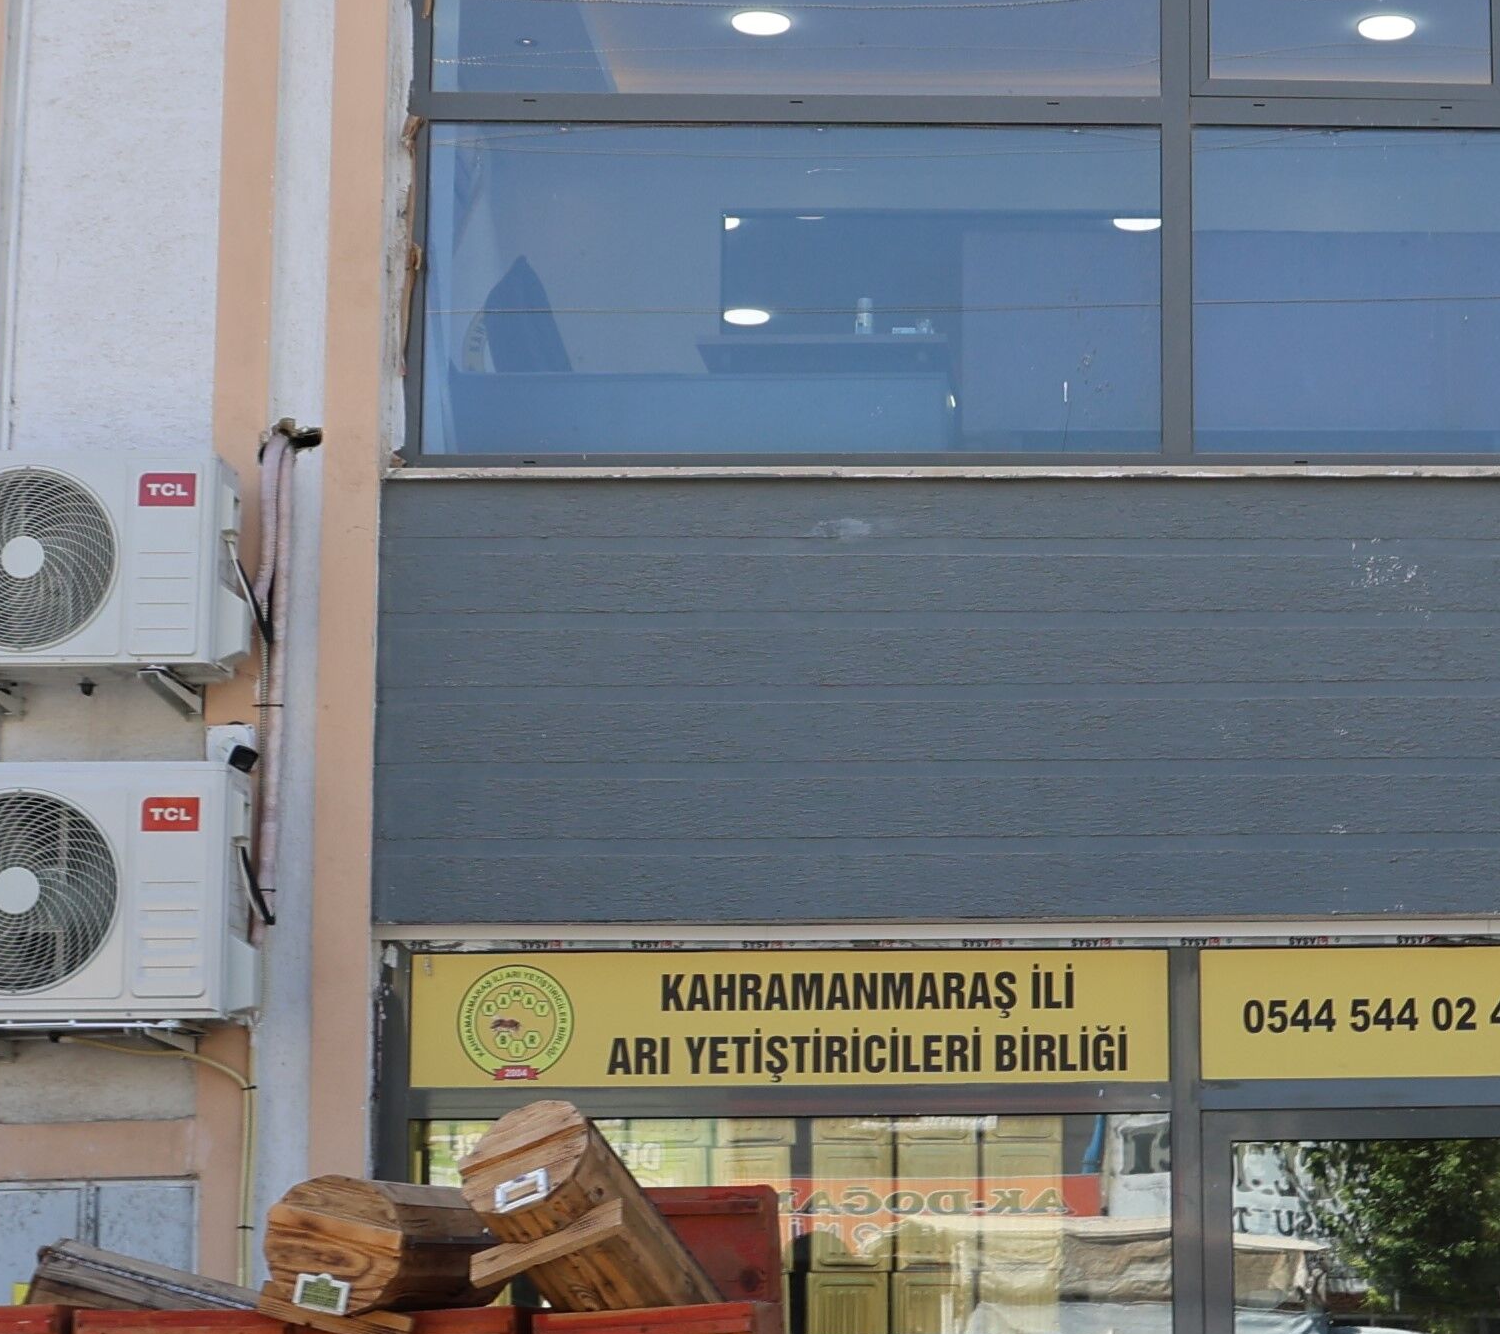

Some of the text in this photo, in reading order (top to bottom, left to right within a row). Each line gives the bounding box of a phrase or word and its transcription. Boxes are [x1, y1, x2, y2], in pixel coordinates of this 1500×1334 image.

[146, 482, 188, 497] TCL
[150, 806, 192, 822] TCL
[486, 988, 545, 1014] KAMAY
[660, 961, 1075, 1022] KAHRAMANMARAŞ İLİ
[1242, 998, 1336, 1036] 0544
[1351, 997, 1418, 1033] 544
[1430, 996, 1478, 1031] 02
[607, 1020, 1129, 1085] ARI YETİŞTİRİCİLERİ BİRLİĞİ
